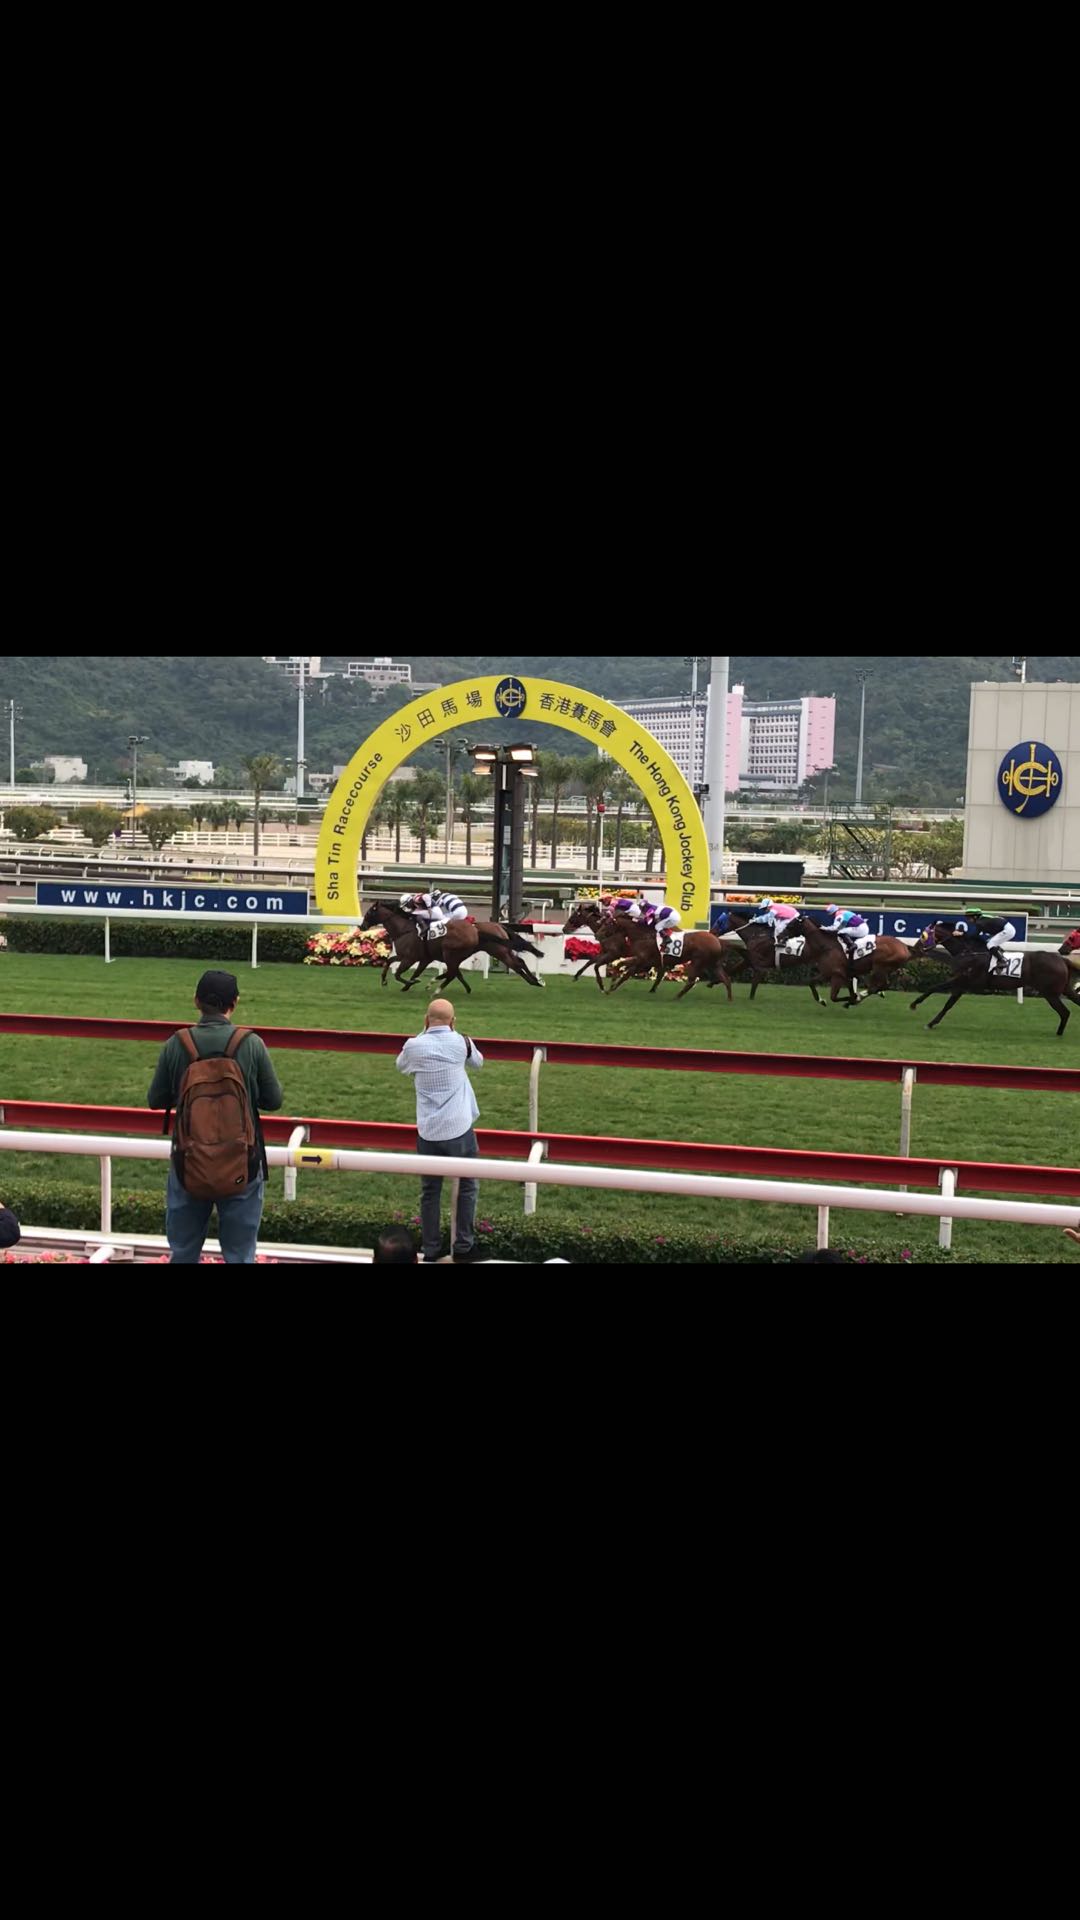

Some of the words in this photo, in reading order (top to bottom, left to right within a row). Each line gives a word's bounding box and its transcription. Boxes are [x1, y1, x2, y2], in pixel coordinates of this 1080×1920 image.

[395, 690, 482, 742] 沙田馬場
[539, 693, 617, 738] 香港賽馬會
[628, 740, 649, 765] The
[333, 752, 383, 835] Racecourse
[647, 762, 671, 797] Hong
[666, 795, 687, 831] Kong
[328, 842, 341, 865] Tin
[679, 832, 695, 879] Jockey
[61, 888, 284, 911] www.hkjc.com
[327, 871, 339, 900] Sha
[680, 881, 696, 912] Club
[672, 939, 682, 956] 8
[796, 940, 804, 956] 7
[865, 941, 876, 951] 4
[1006, 958, 1021, 976] 12
